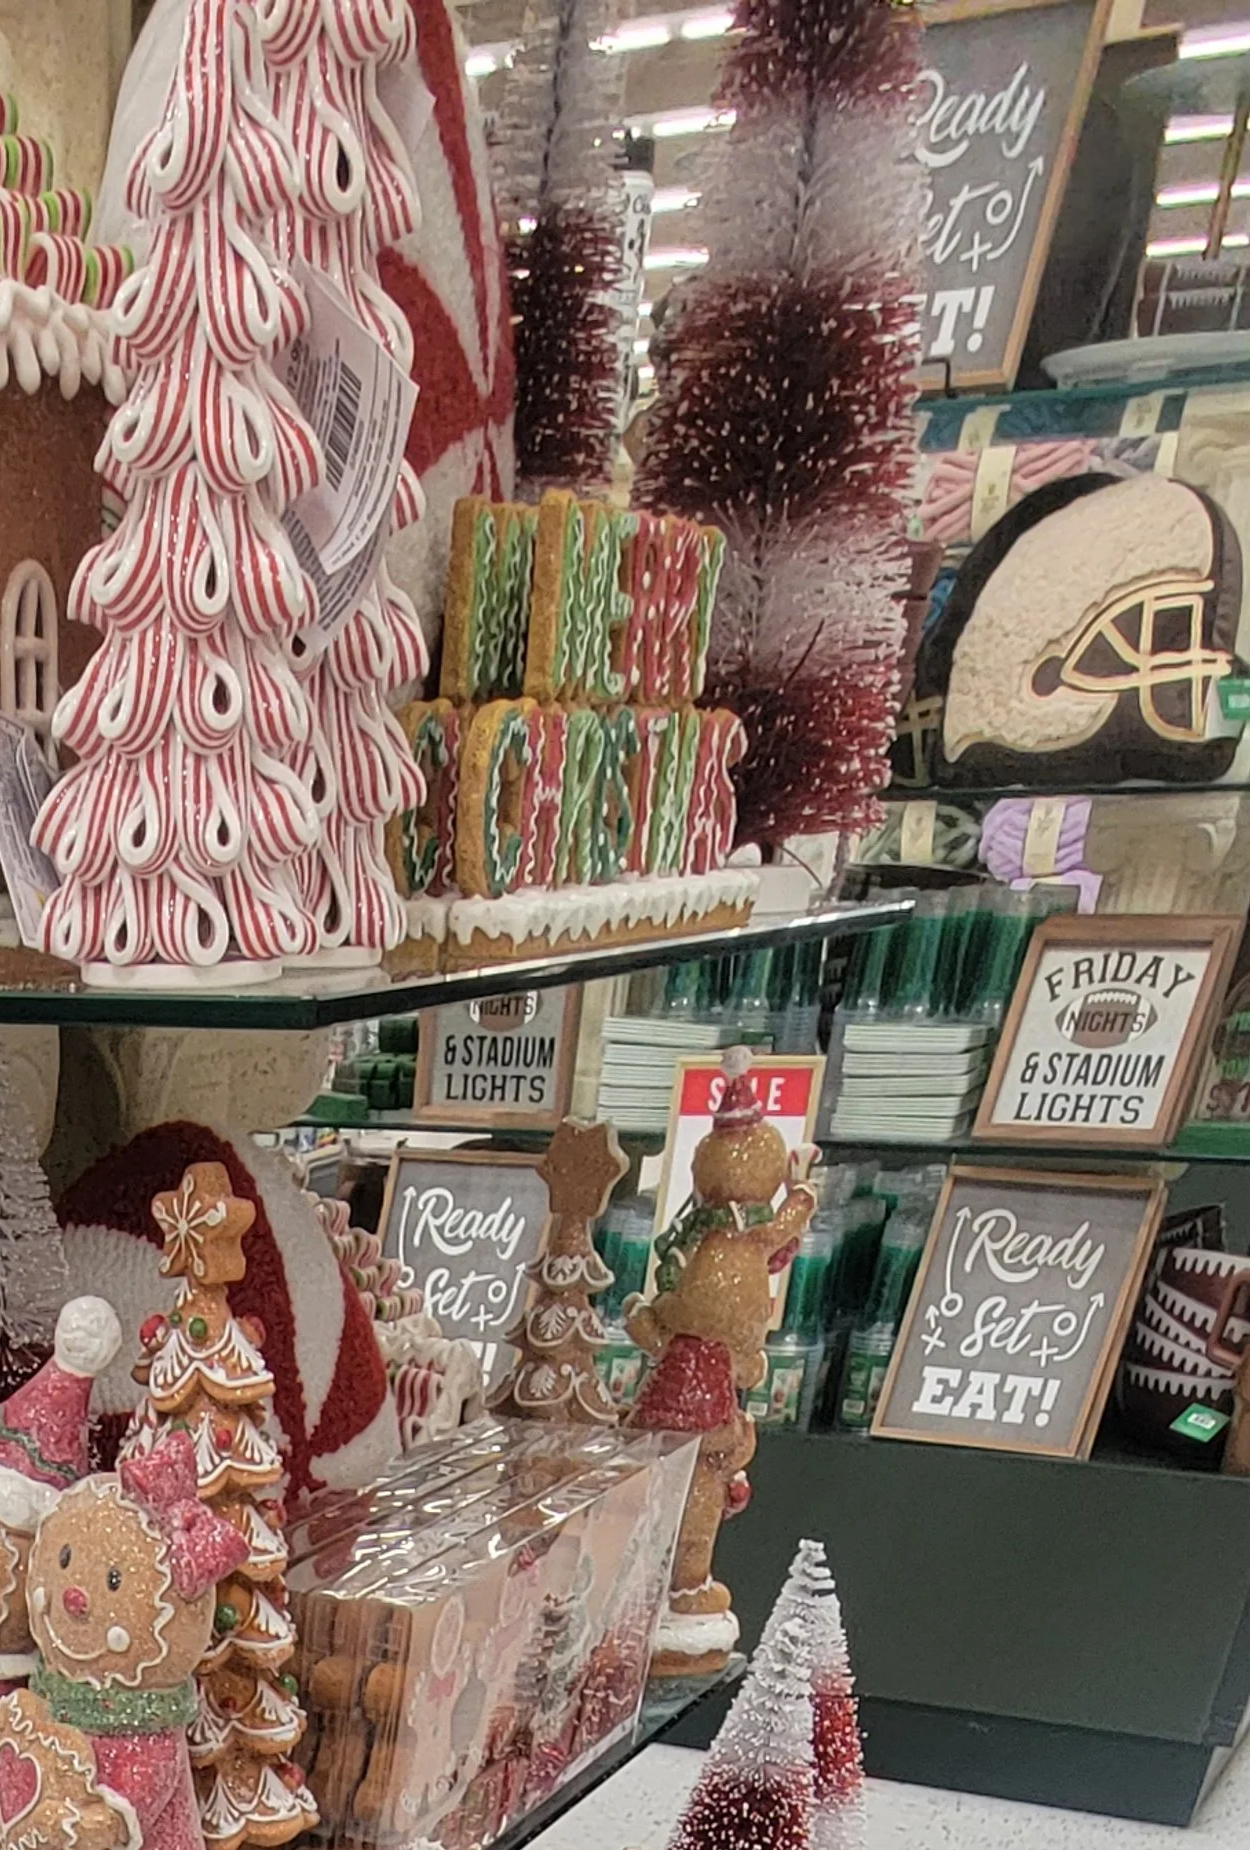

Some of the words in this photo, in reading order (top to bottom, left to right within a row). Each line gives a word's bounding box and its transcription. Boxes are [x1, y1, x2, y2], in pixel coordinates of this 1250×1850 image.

[919, 182, 1000, 265] et
[928, 285, 995, 356] T!
[1044, 951, 1196, 1002] FRIDAY
[1065, 1011, 1147, 1034] NIGHTS
[443, 1035, 456, 1066] &
[461, 1034, 557, 1068] STADIUM
[1020, 1052, 1040, 1085] &
[1042, 1052, 1165, 1088] STADIUM
[445, 1073, 546, 1103] LIGHTS
[708, 1077, 786, 1112] SE
[1013, 1092, 1145, 1125] LIGHTS
[413, 1186, 526, 1261] Ready
[964, 1208, 1105, 1291] Ready
[960, 1296, 1066, 1359] Set
[912, 1365, 1062, 1429] EAT!
